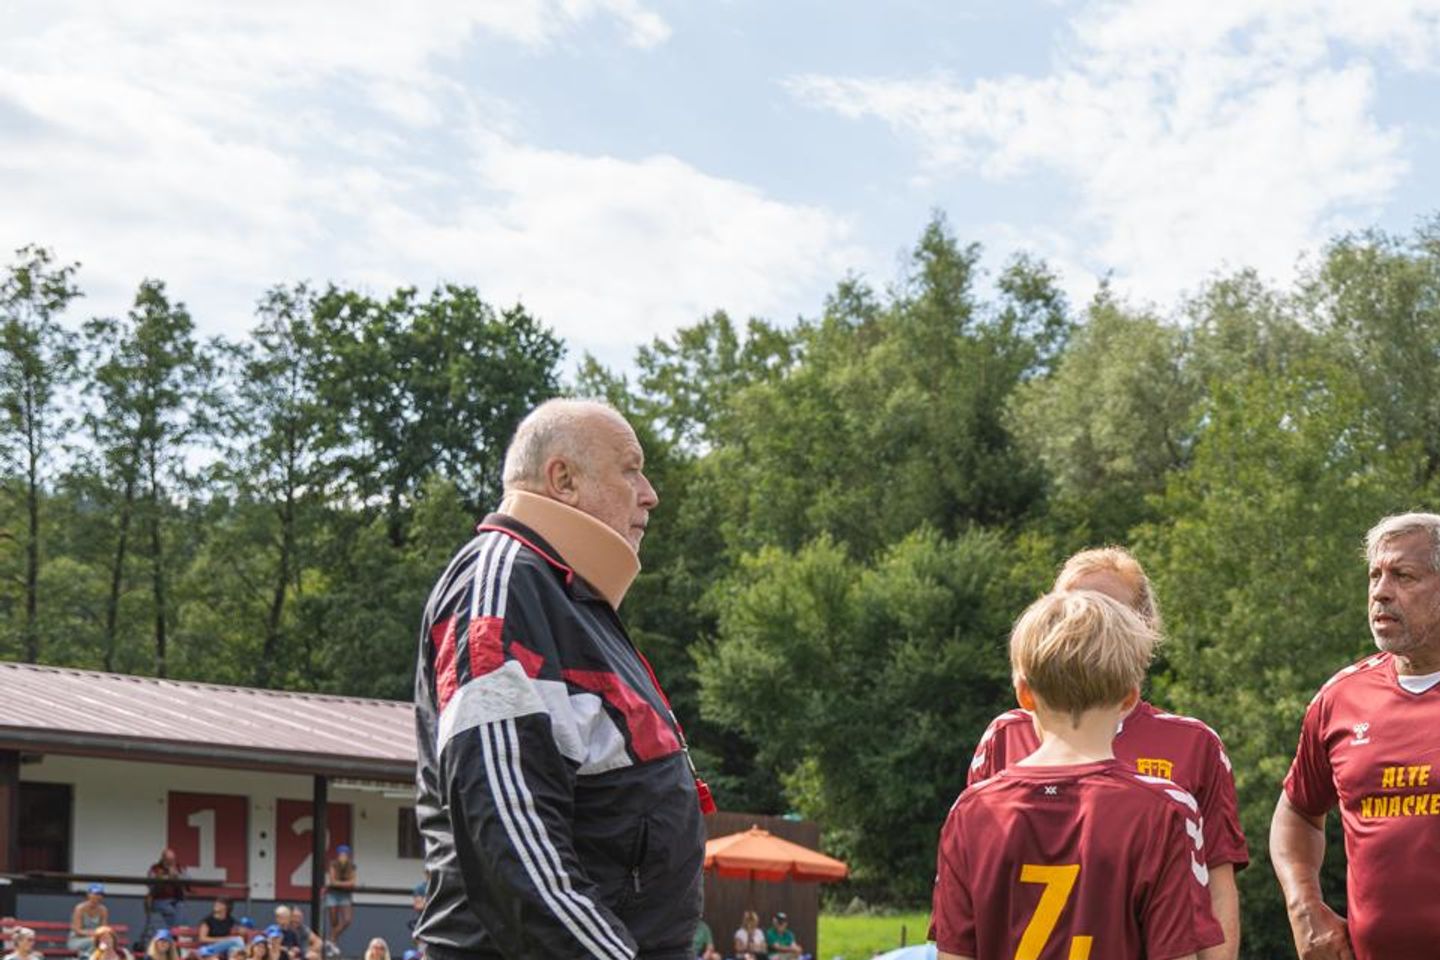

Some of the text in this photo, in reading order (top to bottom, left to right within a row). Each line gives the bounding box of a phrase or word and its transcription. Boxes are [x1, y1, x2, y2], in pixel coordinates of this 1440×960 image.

[1382, 765, 1431, 788] ALTE
[187, 809, 227, 880] 1
[291, 816, 331, 886] 2
